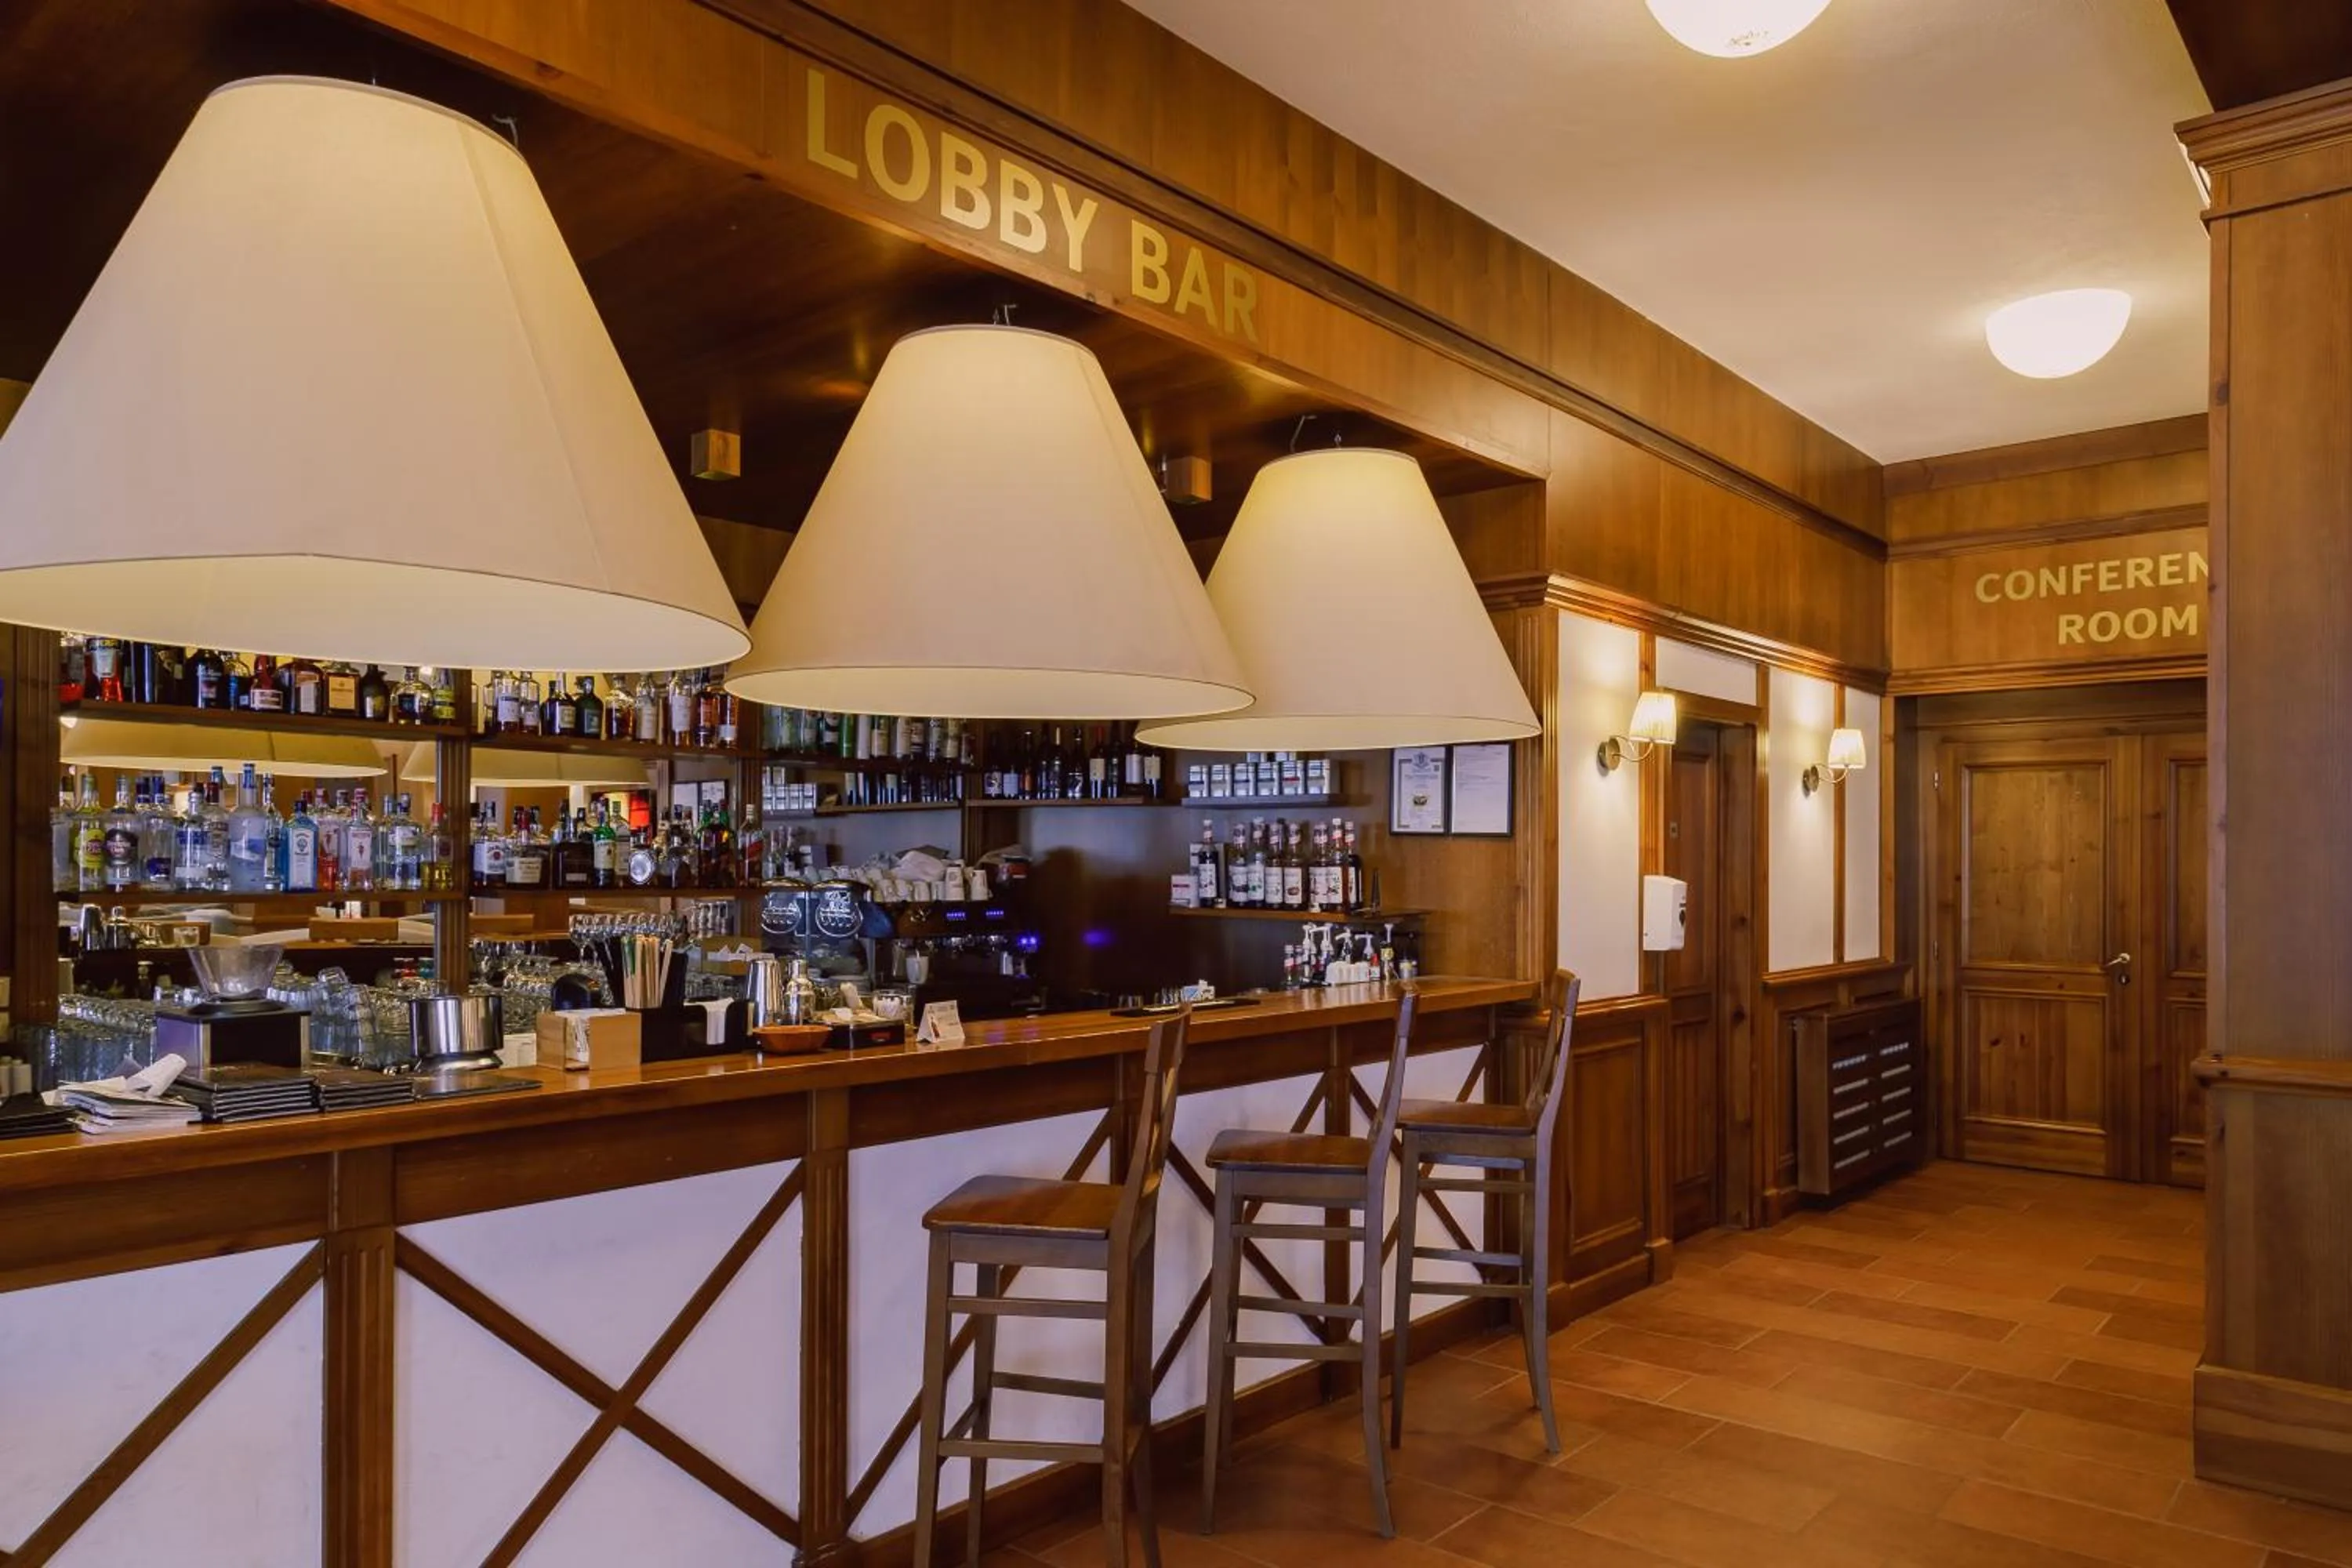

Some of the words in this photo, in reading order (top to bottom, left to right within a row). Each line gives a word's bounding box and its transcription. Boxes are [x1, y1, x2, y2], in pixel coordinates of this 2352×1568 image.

[807, 68, 1098, 272] LOBBY
[1131, 219, 1259, 343] BAR
[2058, 604, 2198, 645] ROOM
